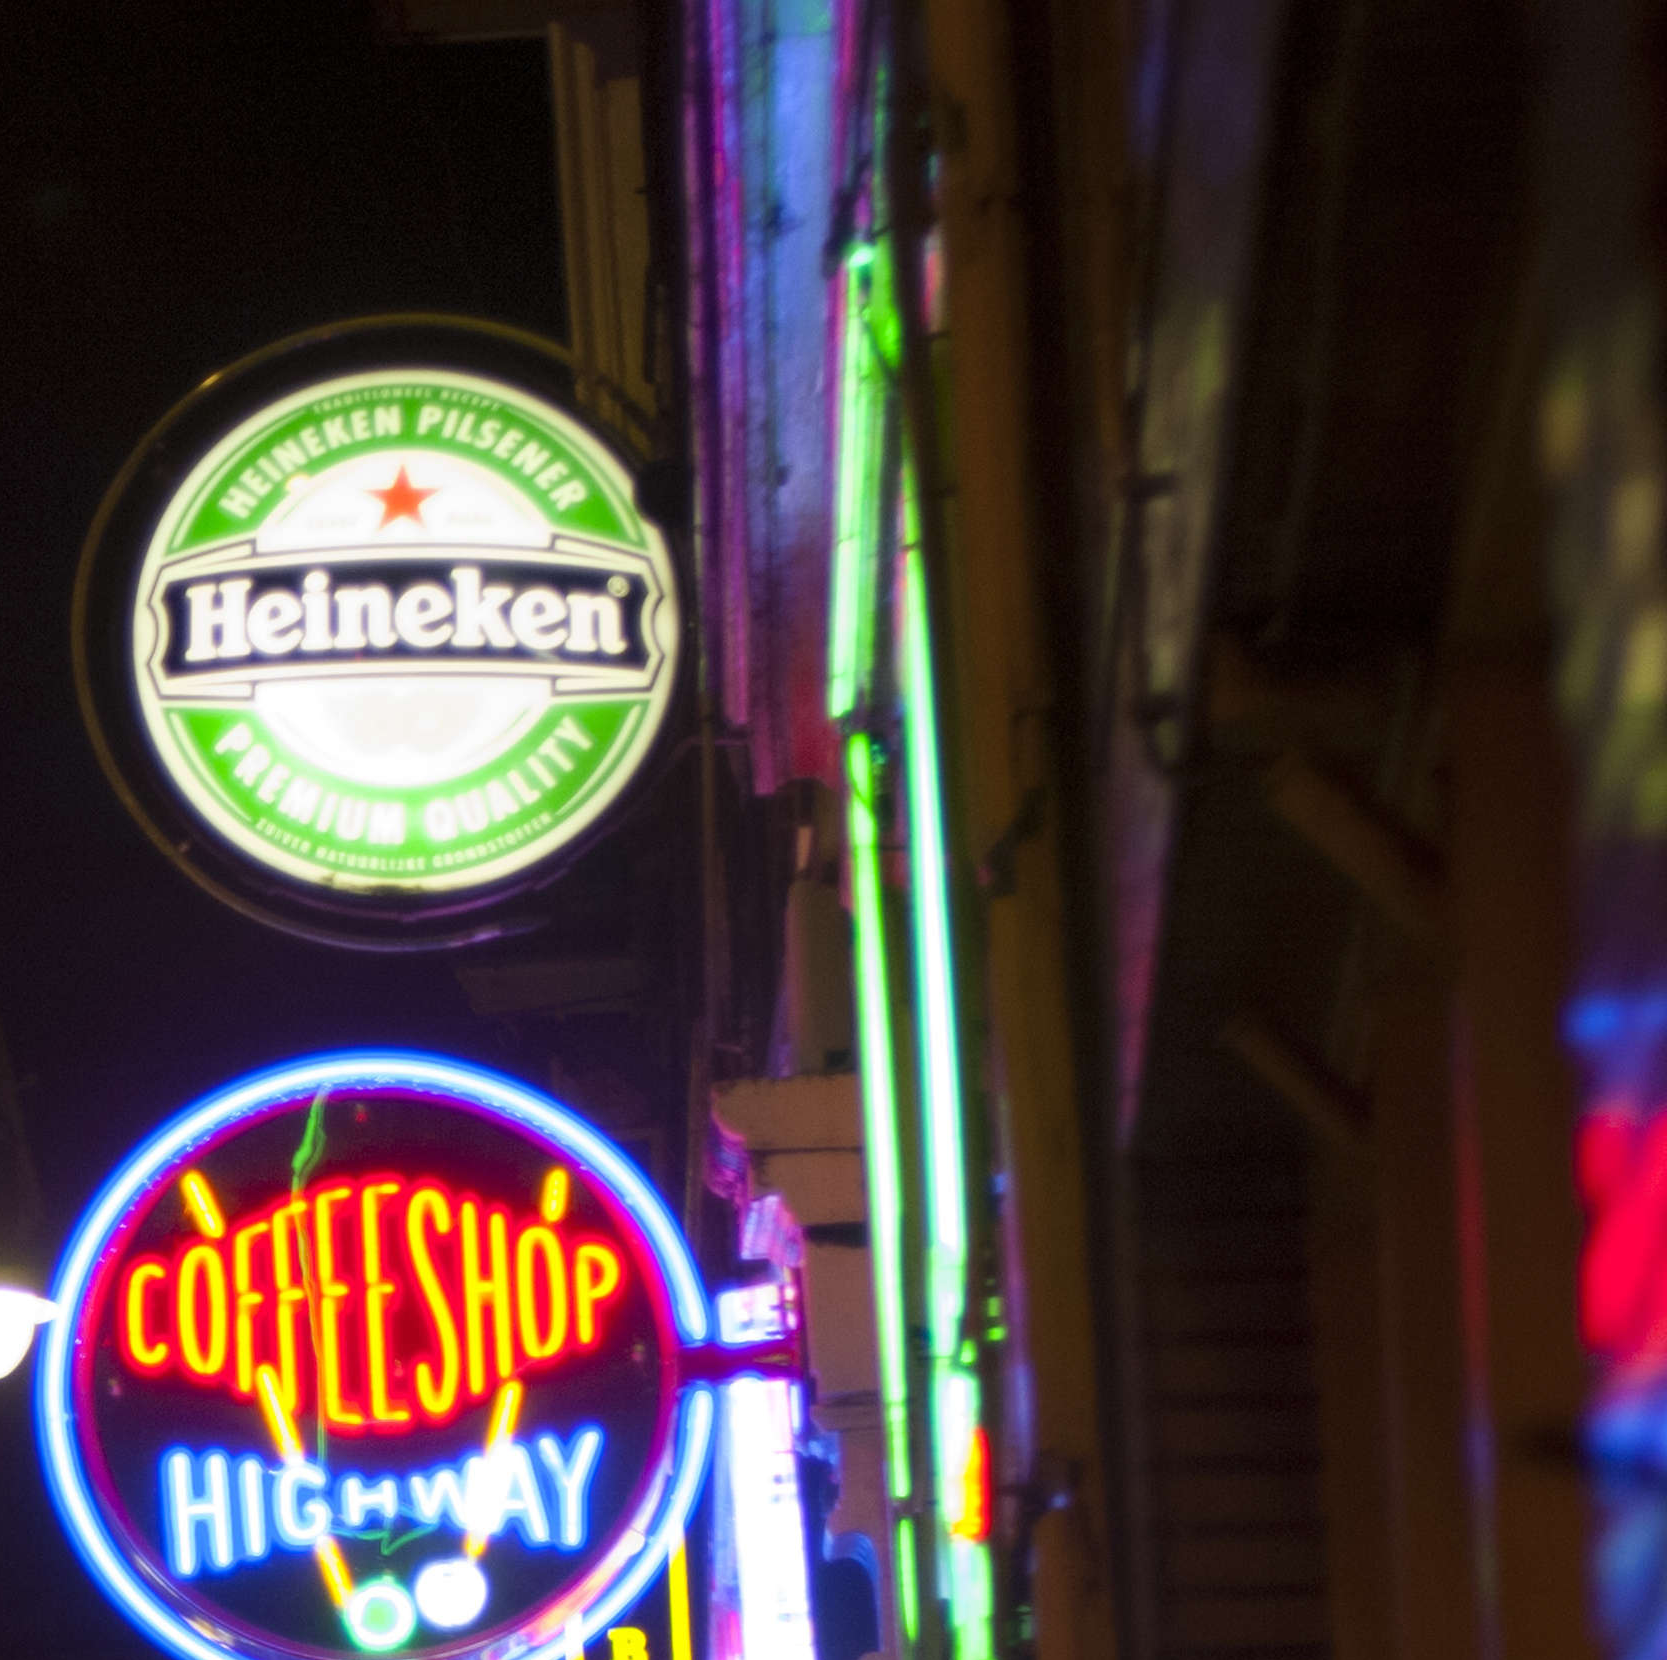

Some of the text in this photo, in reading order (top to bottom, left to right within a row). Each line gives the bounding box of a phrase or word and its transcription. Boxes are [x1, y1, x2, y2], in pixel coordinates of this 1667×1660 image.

[217, 404, 588, 520] HEINEKEN PILSENER
[184, 567, 627, 662] Heineken
[214, 716, 595, 846] PREMIUM QUALITY
[126, 1182, 620, 1424] COFFEESHOP
[167, 1434, 601, 1575] HIGHWAY
